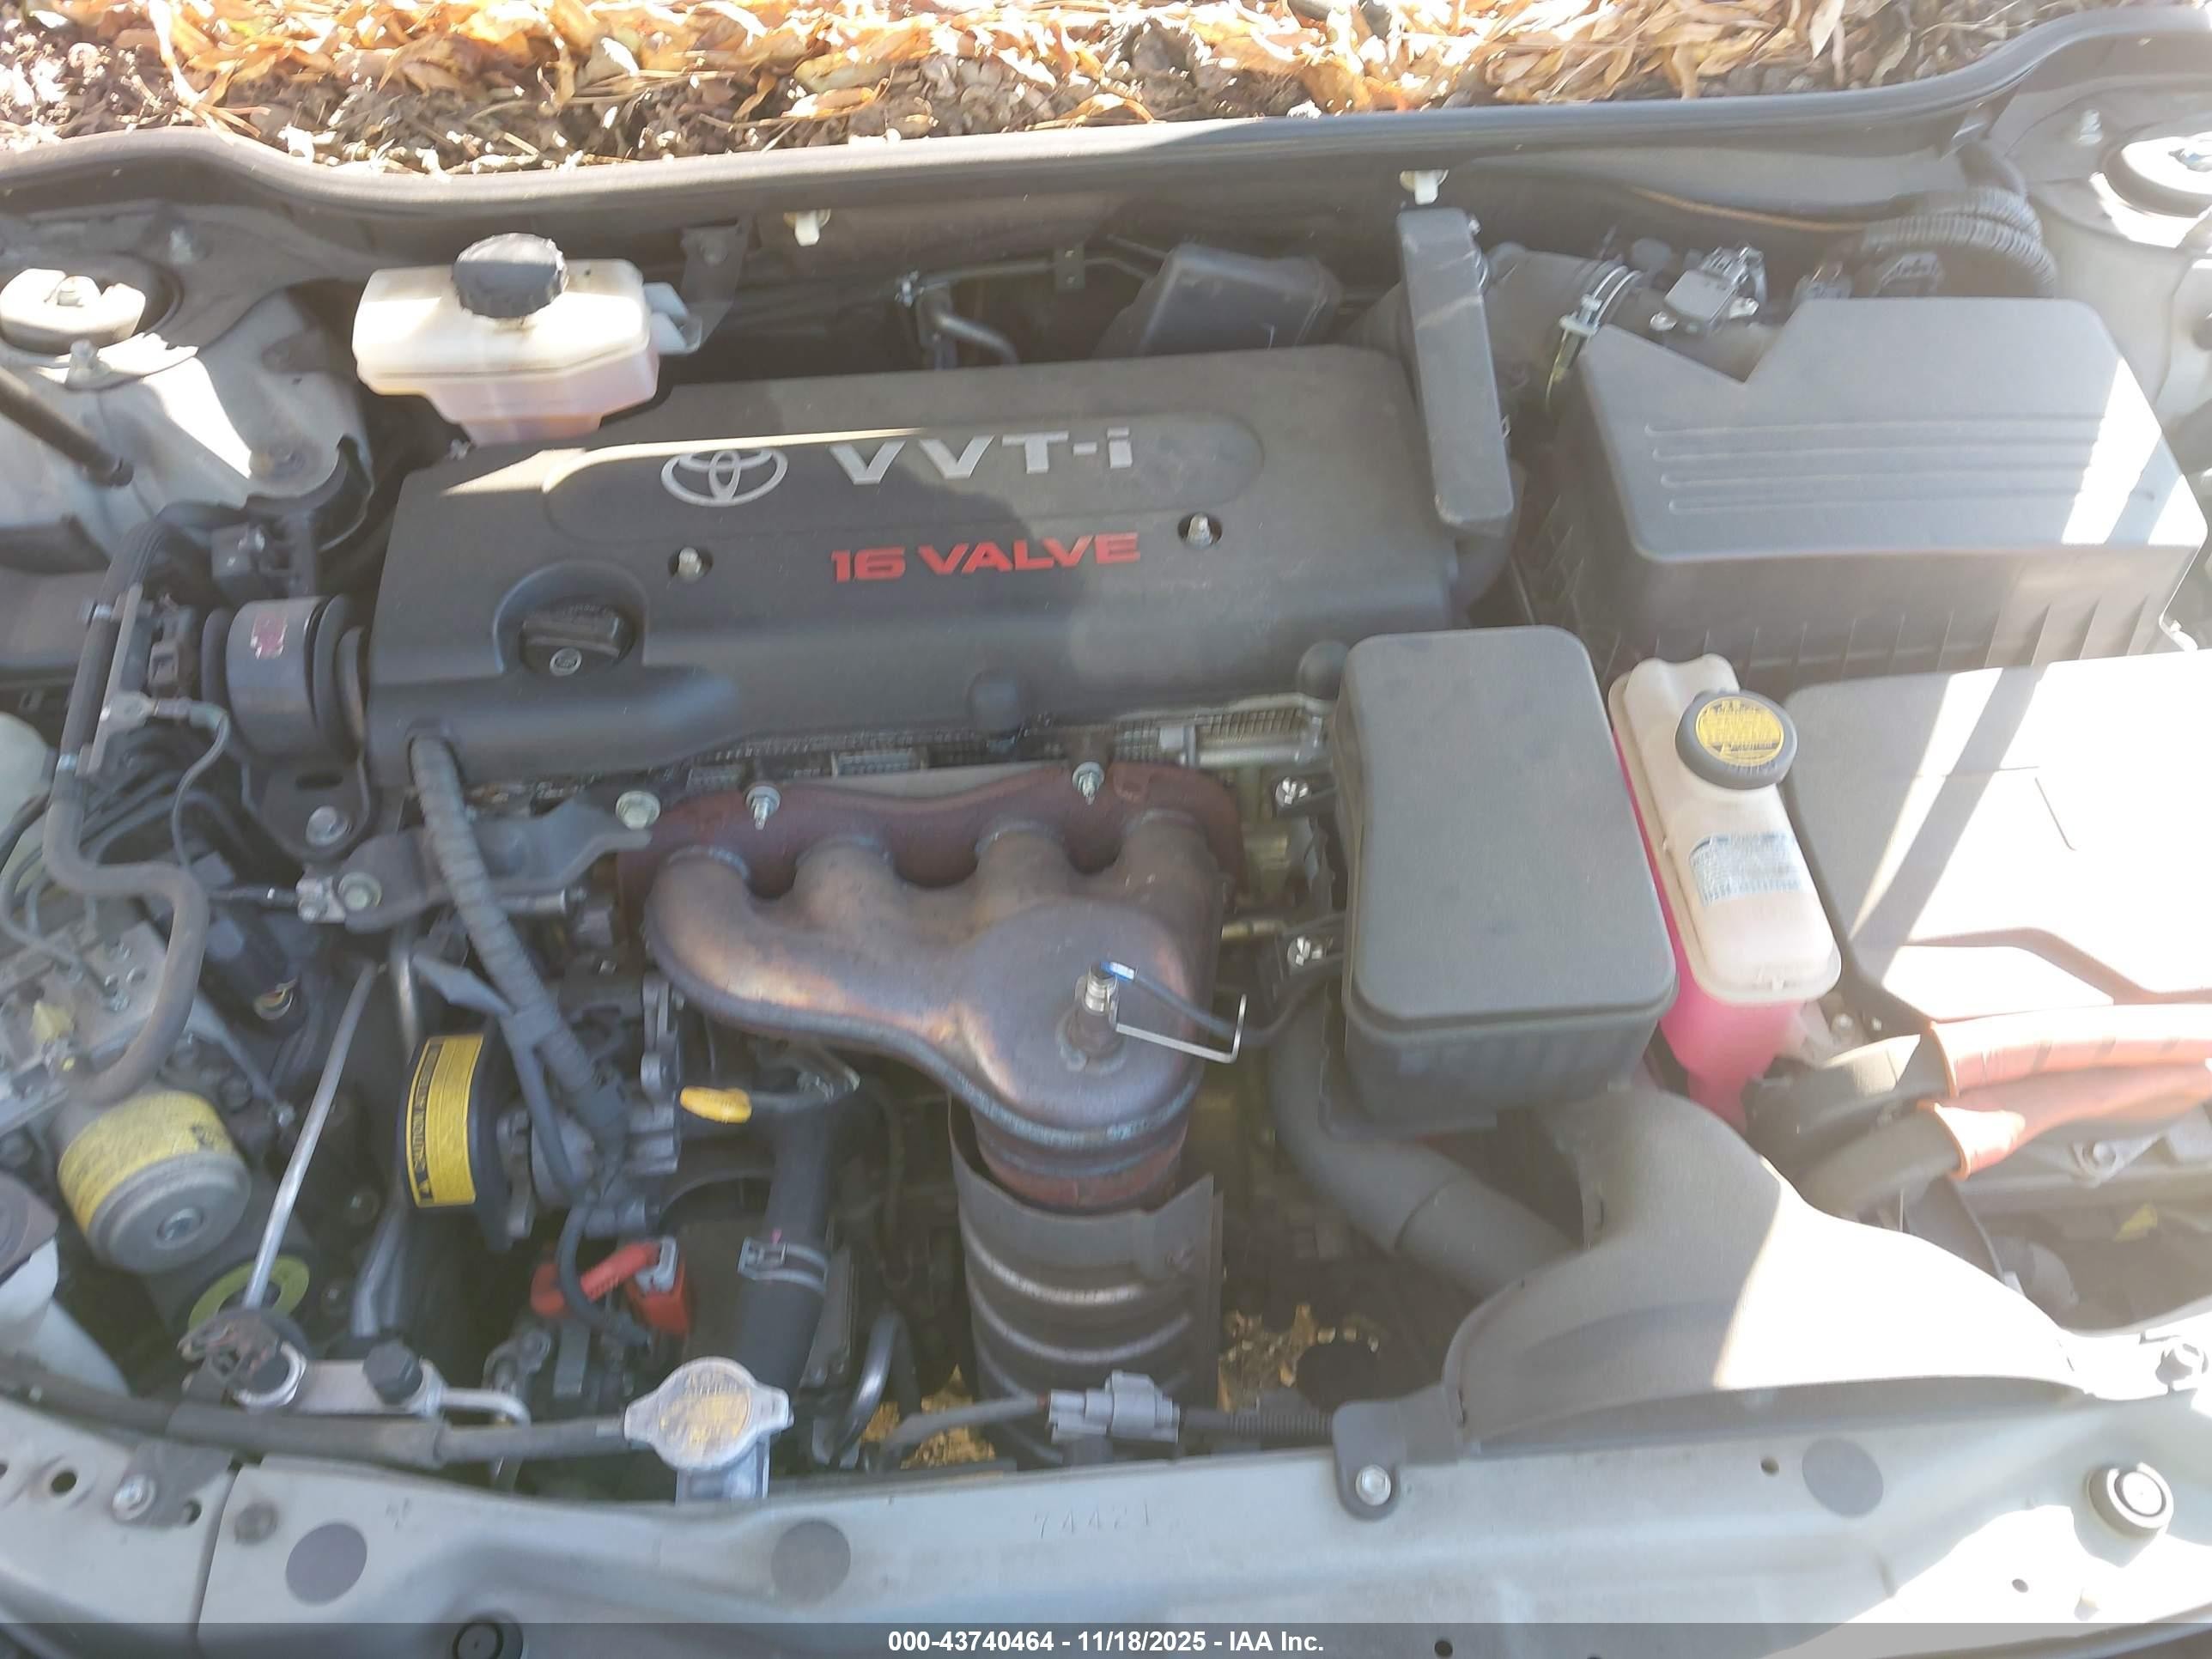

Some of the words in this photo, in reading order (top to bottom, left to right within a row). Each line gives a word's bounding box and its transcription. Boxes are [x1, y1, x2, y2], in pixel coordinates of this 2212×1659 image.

[829, 427, 1133, 485] VVT-i
[831, 544, 906, 582] 16
[918, 531, 1140, 575] VALVE
